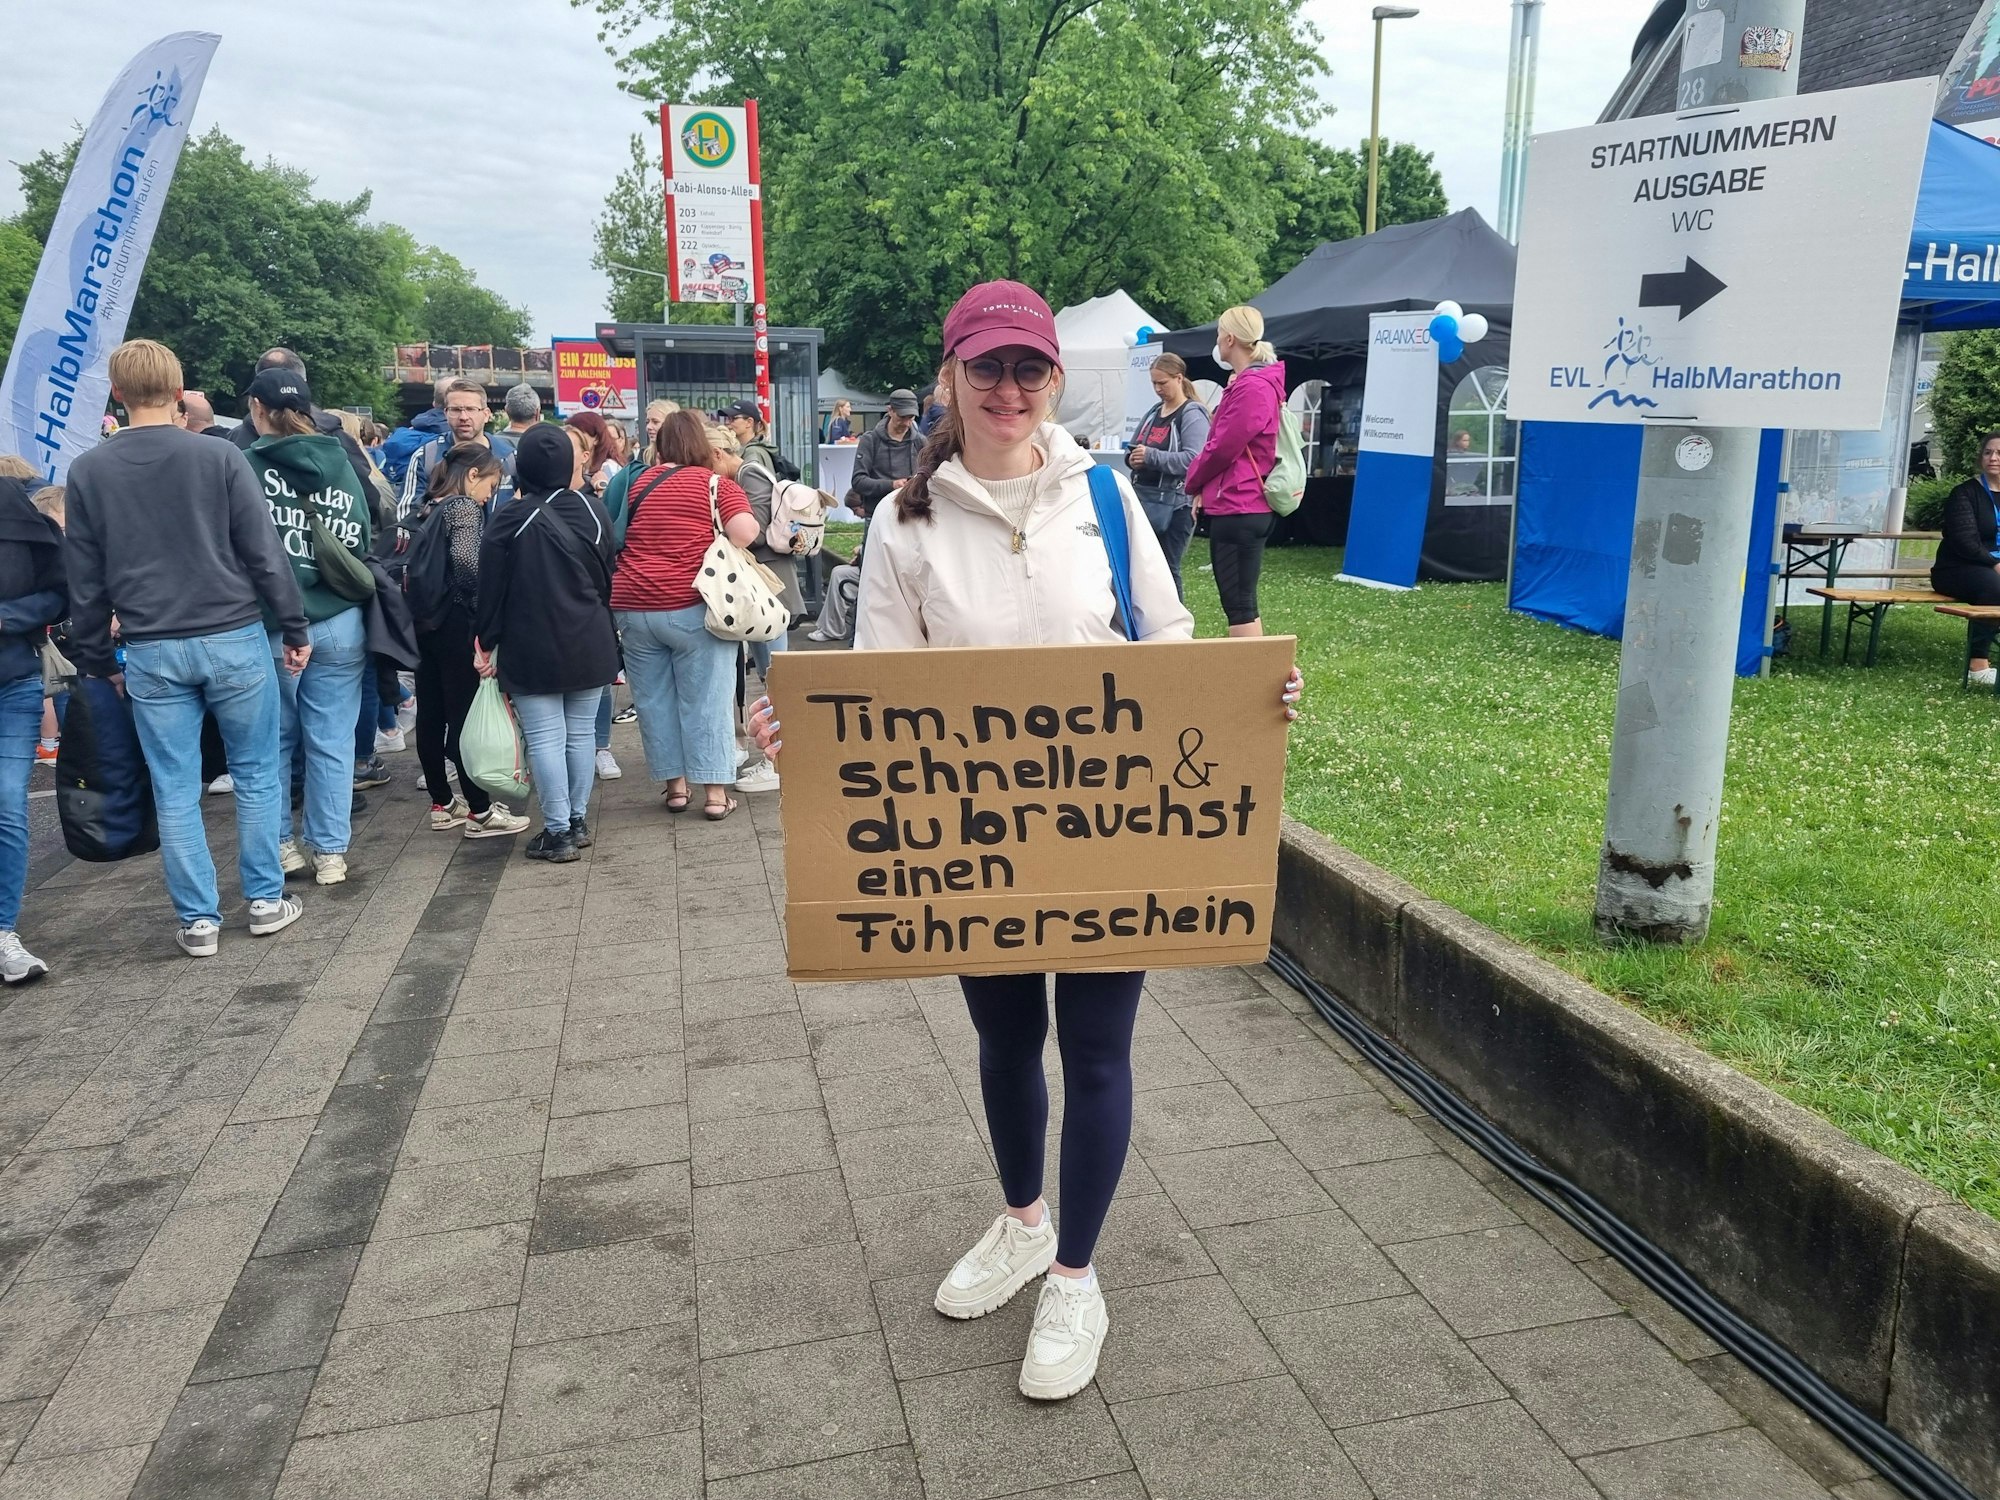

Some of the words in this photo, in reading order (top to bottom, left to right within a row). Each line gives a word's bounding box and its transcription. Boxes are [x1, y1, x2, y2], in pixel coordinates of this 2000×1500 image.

[1680, 77, 1705, 109] 28
[1591, 115, 1837, 169] STARTNUMMERN
[673, 181, 753, 197] Xabi-Alonso-Allee
[1633, 166, 1766, 203] AUSGABE
[679, 208, 696, 217] 203
[1671, 209, 1714, 234] WC
[100, 159, 159, 320] #willstdumitmirlaufen
[680, 225, 697, 234] 207
[681, 241, 698, 250] 222
[1374, 328, 1431, 345] ARLANXEO
[560, 352, 579, 367] EIN
[560, 369, 576, 378] ZUM
[577, 369, 611, 379] ANLEHNEN
[1550, 366, 1591, 388] EVL
[1652, 366, 1841, 391] HalbMarathon
[1365, 415, 1394, 425] Welcome
[1363, 429, 1404, 440] Willkommen
[973, 672, 1143, 744] noch
[839, 745, 1154, 798] schneller
[1172, 727, 1219, 788] &
[847, 796, 942, 853] du
[960, 785, 1256, 845] brauchst
[857, 854, 1014, 898] einen
[836, 893, 1256, 953] Führerschein
